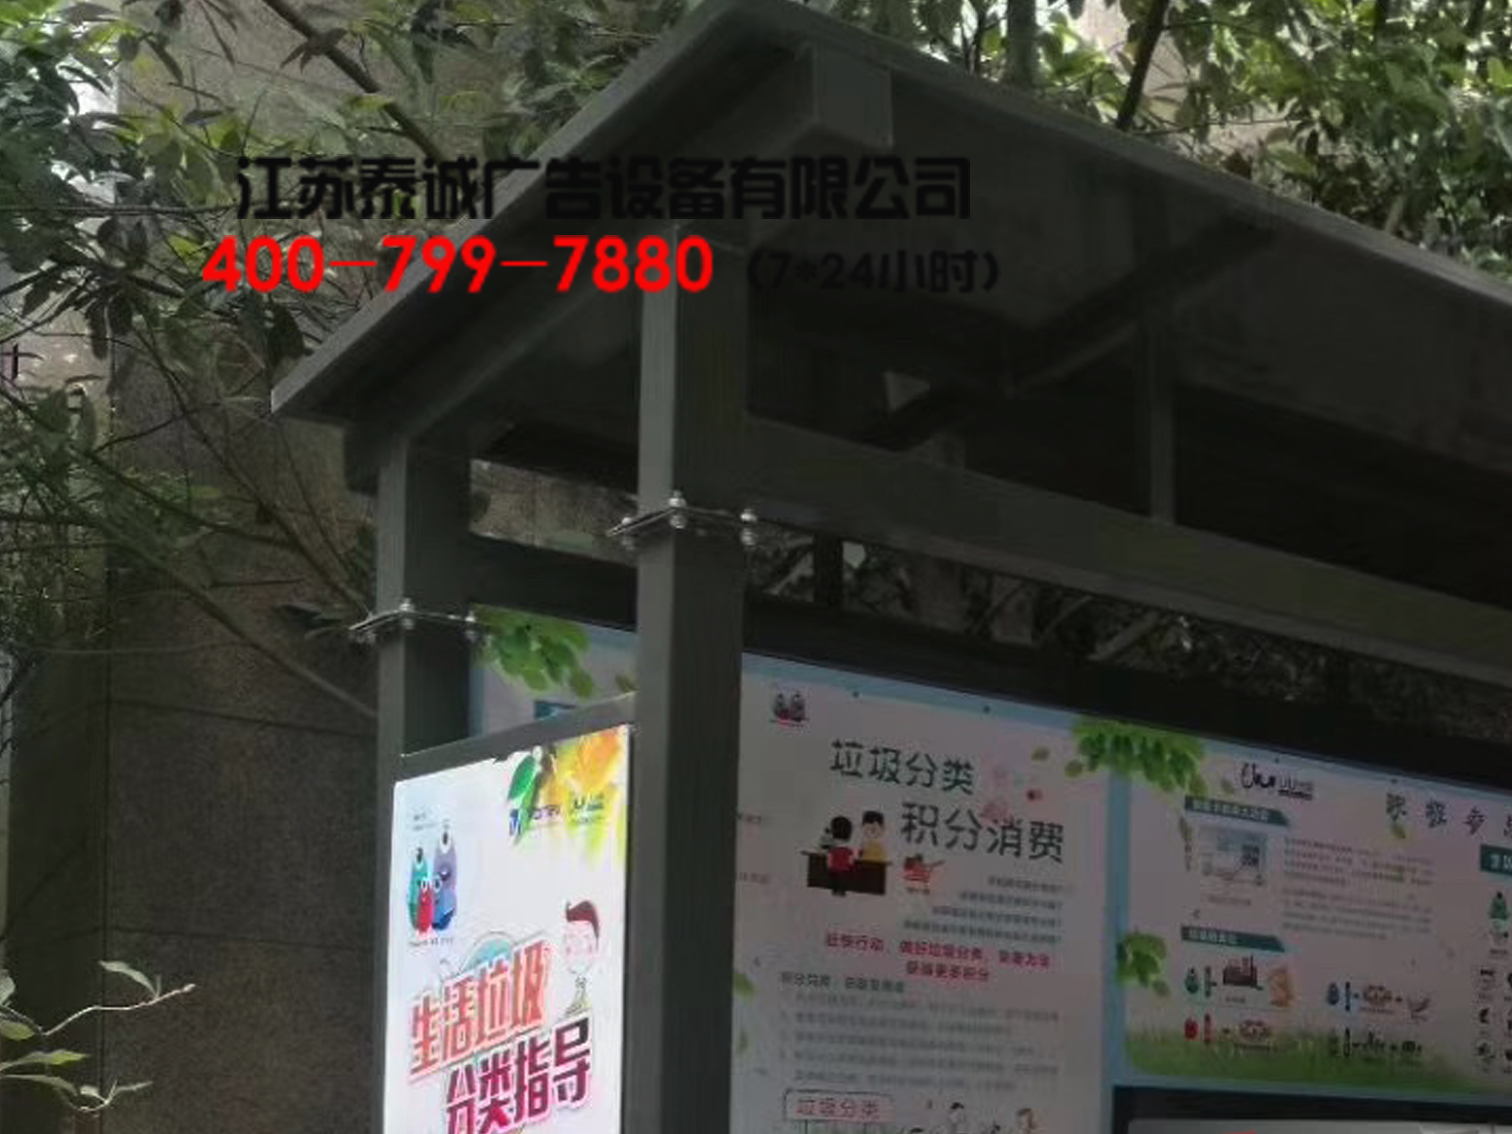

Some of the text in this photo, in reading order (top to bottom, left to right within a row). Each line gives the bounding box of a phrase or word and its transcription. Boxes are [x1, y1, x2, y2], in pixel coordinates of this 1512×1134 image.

[830, 740, 975, 795] 垃圾分类
[900, 802, 1065, 863] 积分消费
[409, 937, 551, 1077] 生活垃圾
